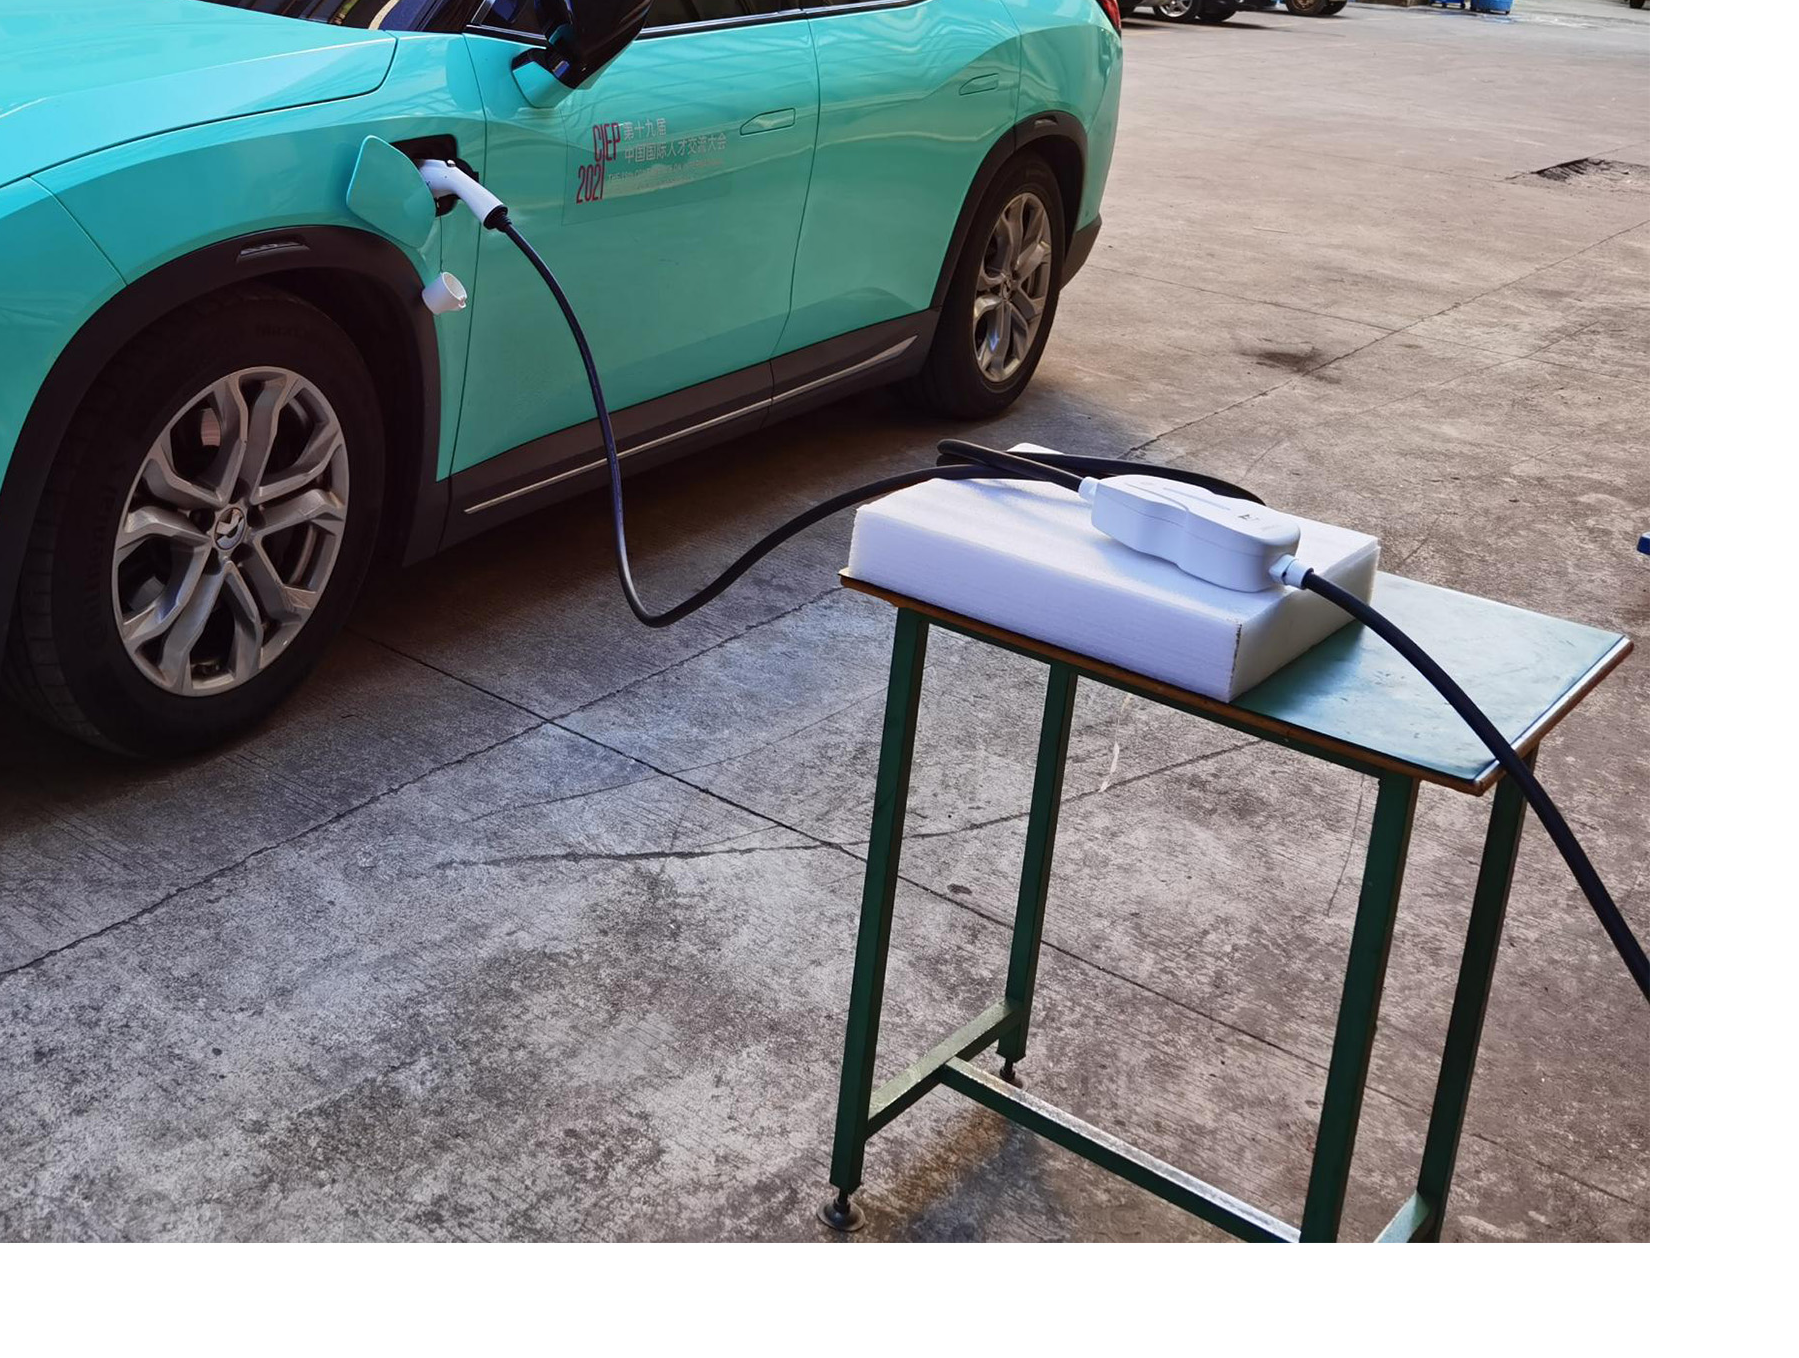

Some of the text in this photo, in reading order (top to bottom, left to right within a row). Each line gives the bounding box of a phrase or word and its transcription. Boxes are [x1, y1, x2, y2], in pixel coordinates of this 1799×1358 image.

[623, 117, 667, 140] 第十九届
[625, 132, 727, 163] 中国国际人才交流大会
